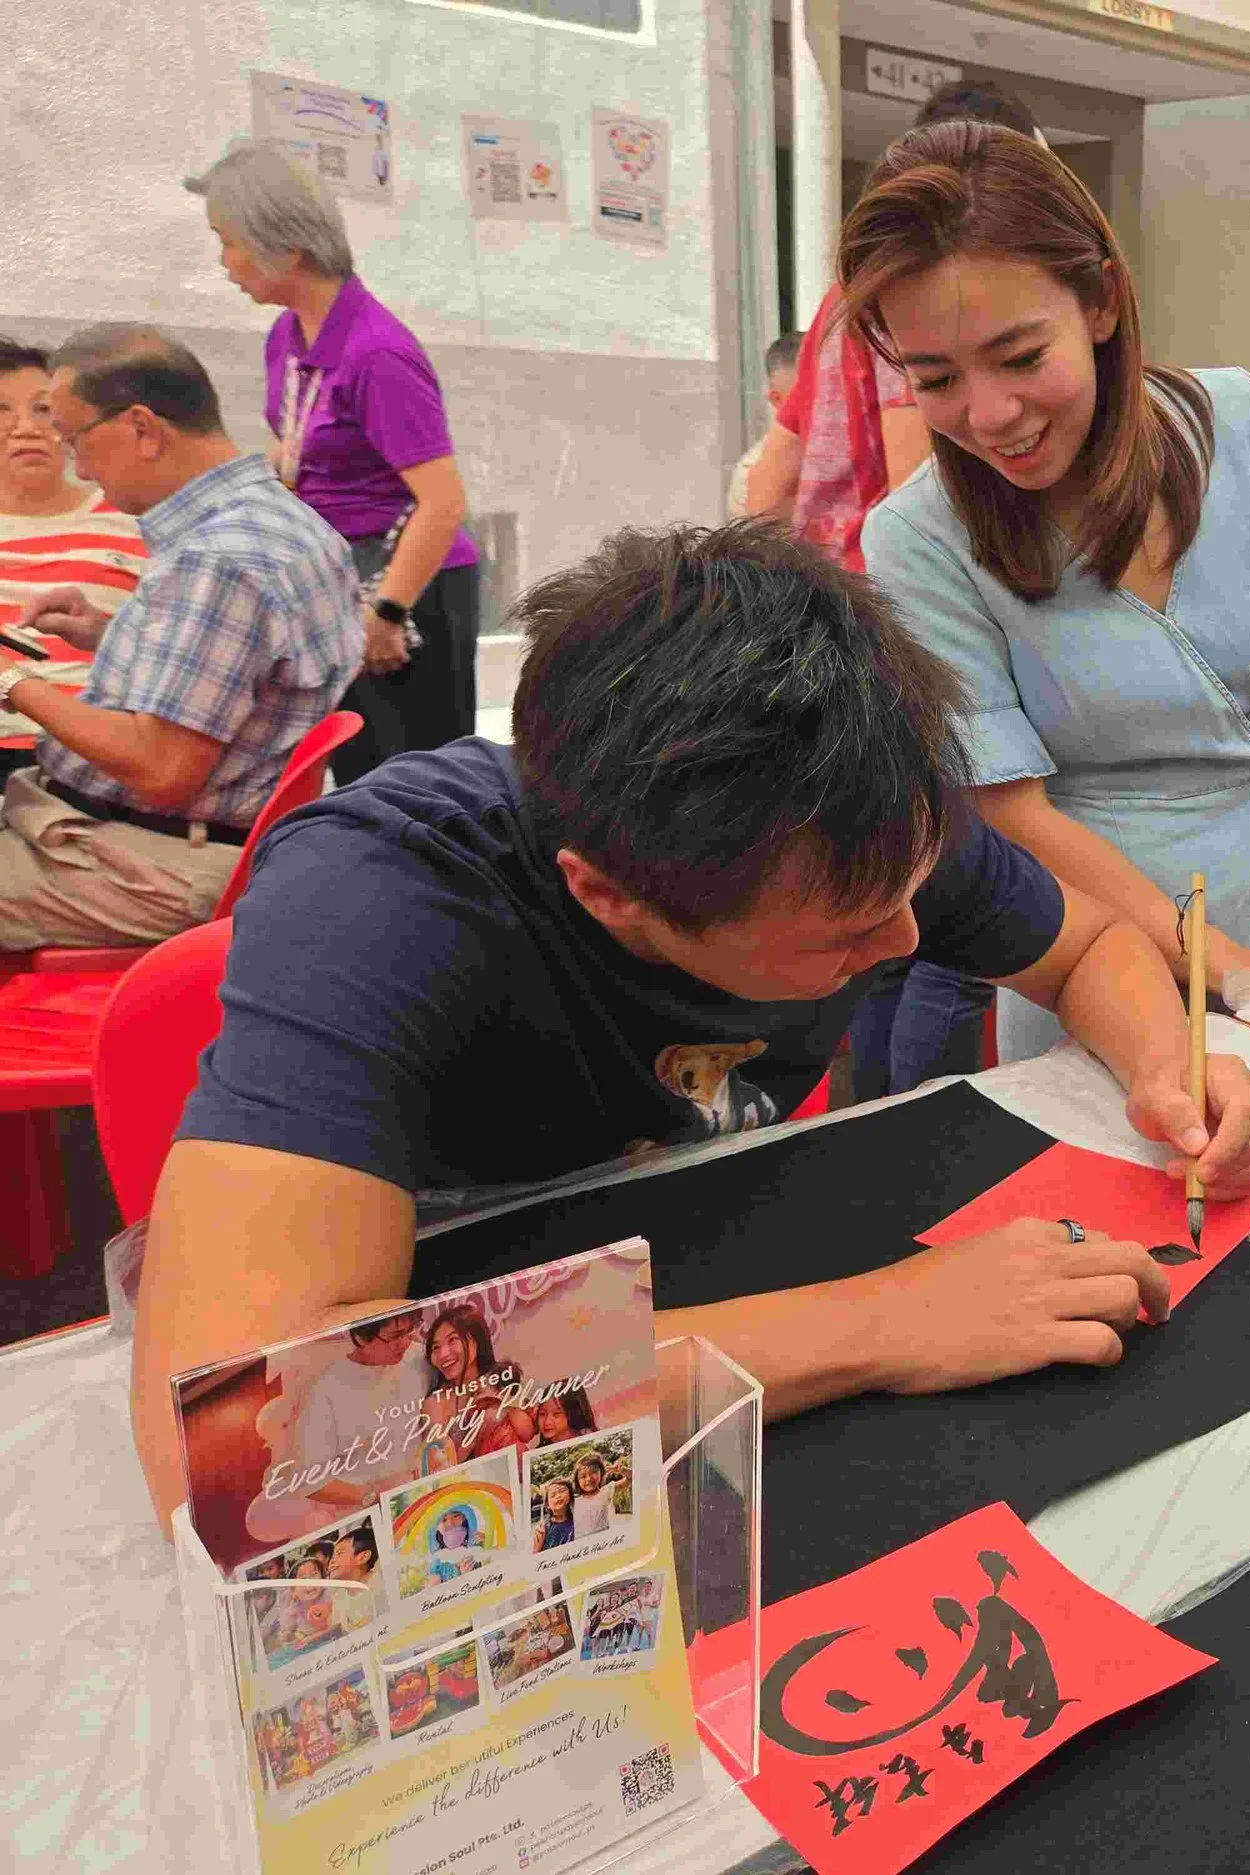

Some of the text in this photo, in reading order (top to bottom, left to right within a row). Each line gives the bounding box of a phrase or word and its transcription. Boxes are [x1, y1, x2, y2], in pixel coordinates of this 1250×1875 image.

[374, 1365, 514, 1424] Your Trusted
[264, 1363, 611, 1501] Event & Party Planner
[560, 1551, 582, 1565] Hand
[590, 1540, 608, 1553] Hair
[420, 1571, 504, 1613] Balloon Sculpting
[500, 1688, 518, 1704] Live
[540, 1658, 573, 1682] Stations
[592, 1658, 640, 1675] Workshops
[416, 1720, 454, 1746] Rental
[381, 1791, 404, 1808] We
[405, 1770, 448, 1798] deliver
[506, 1709, 575, 1749] Experiences
[328, 1703, 629, 1871] Experience the difference with Us!
[448, 1841, 476, 1862] Soul
[477, 1832, 501, 1846] Pte.
[502, 1817, 525, 1835] Ltd.
